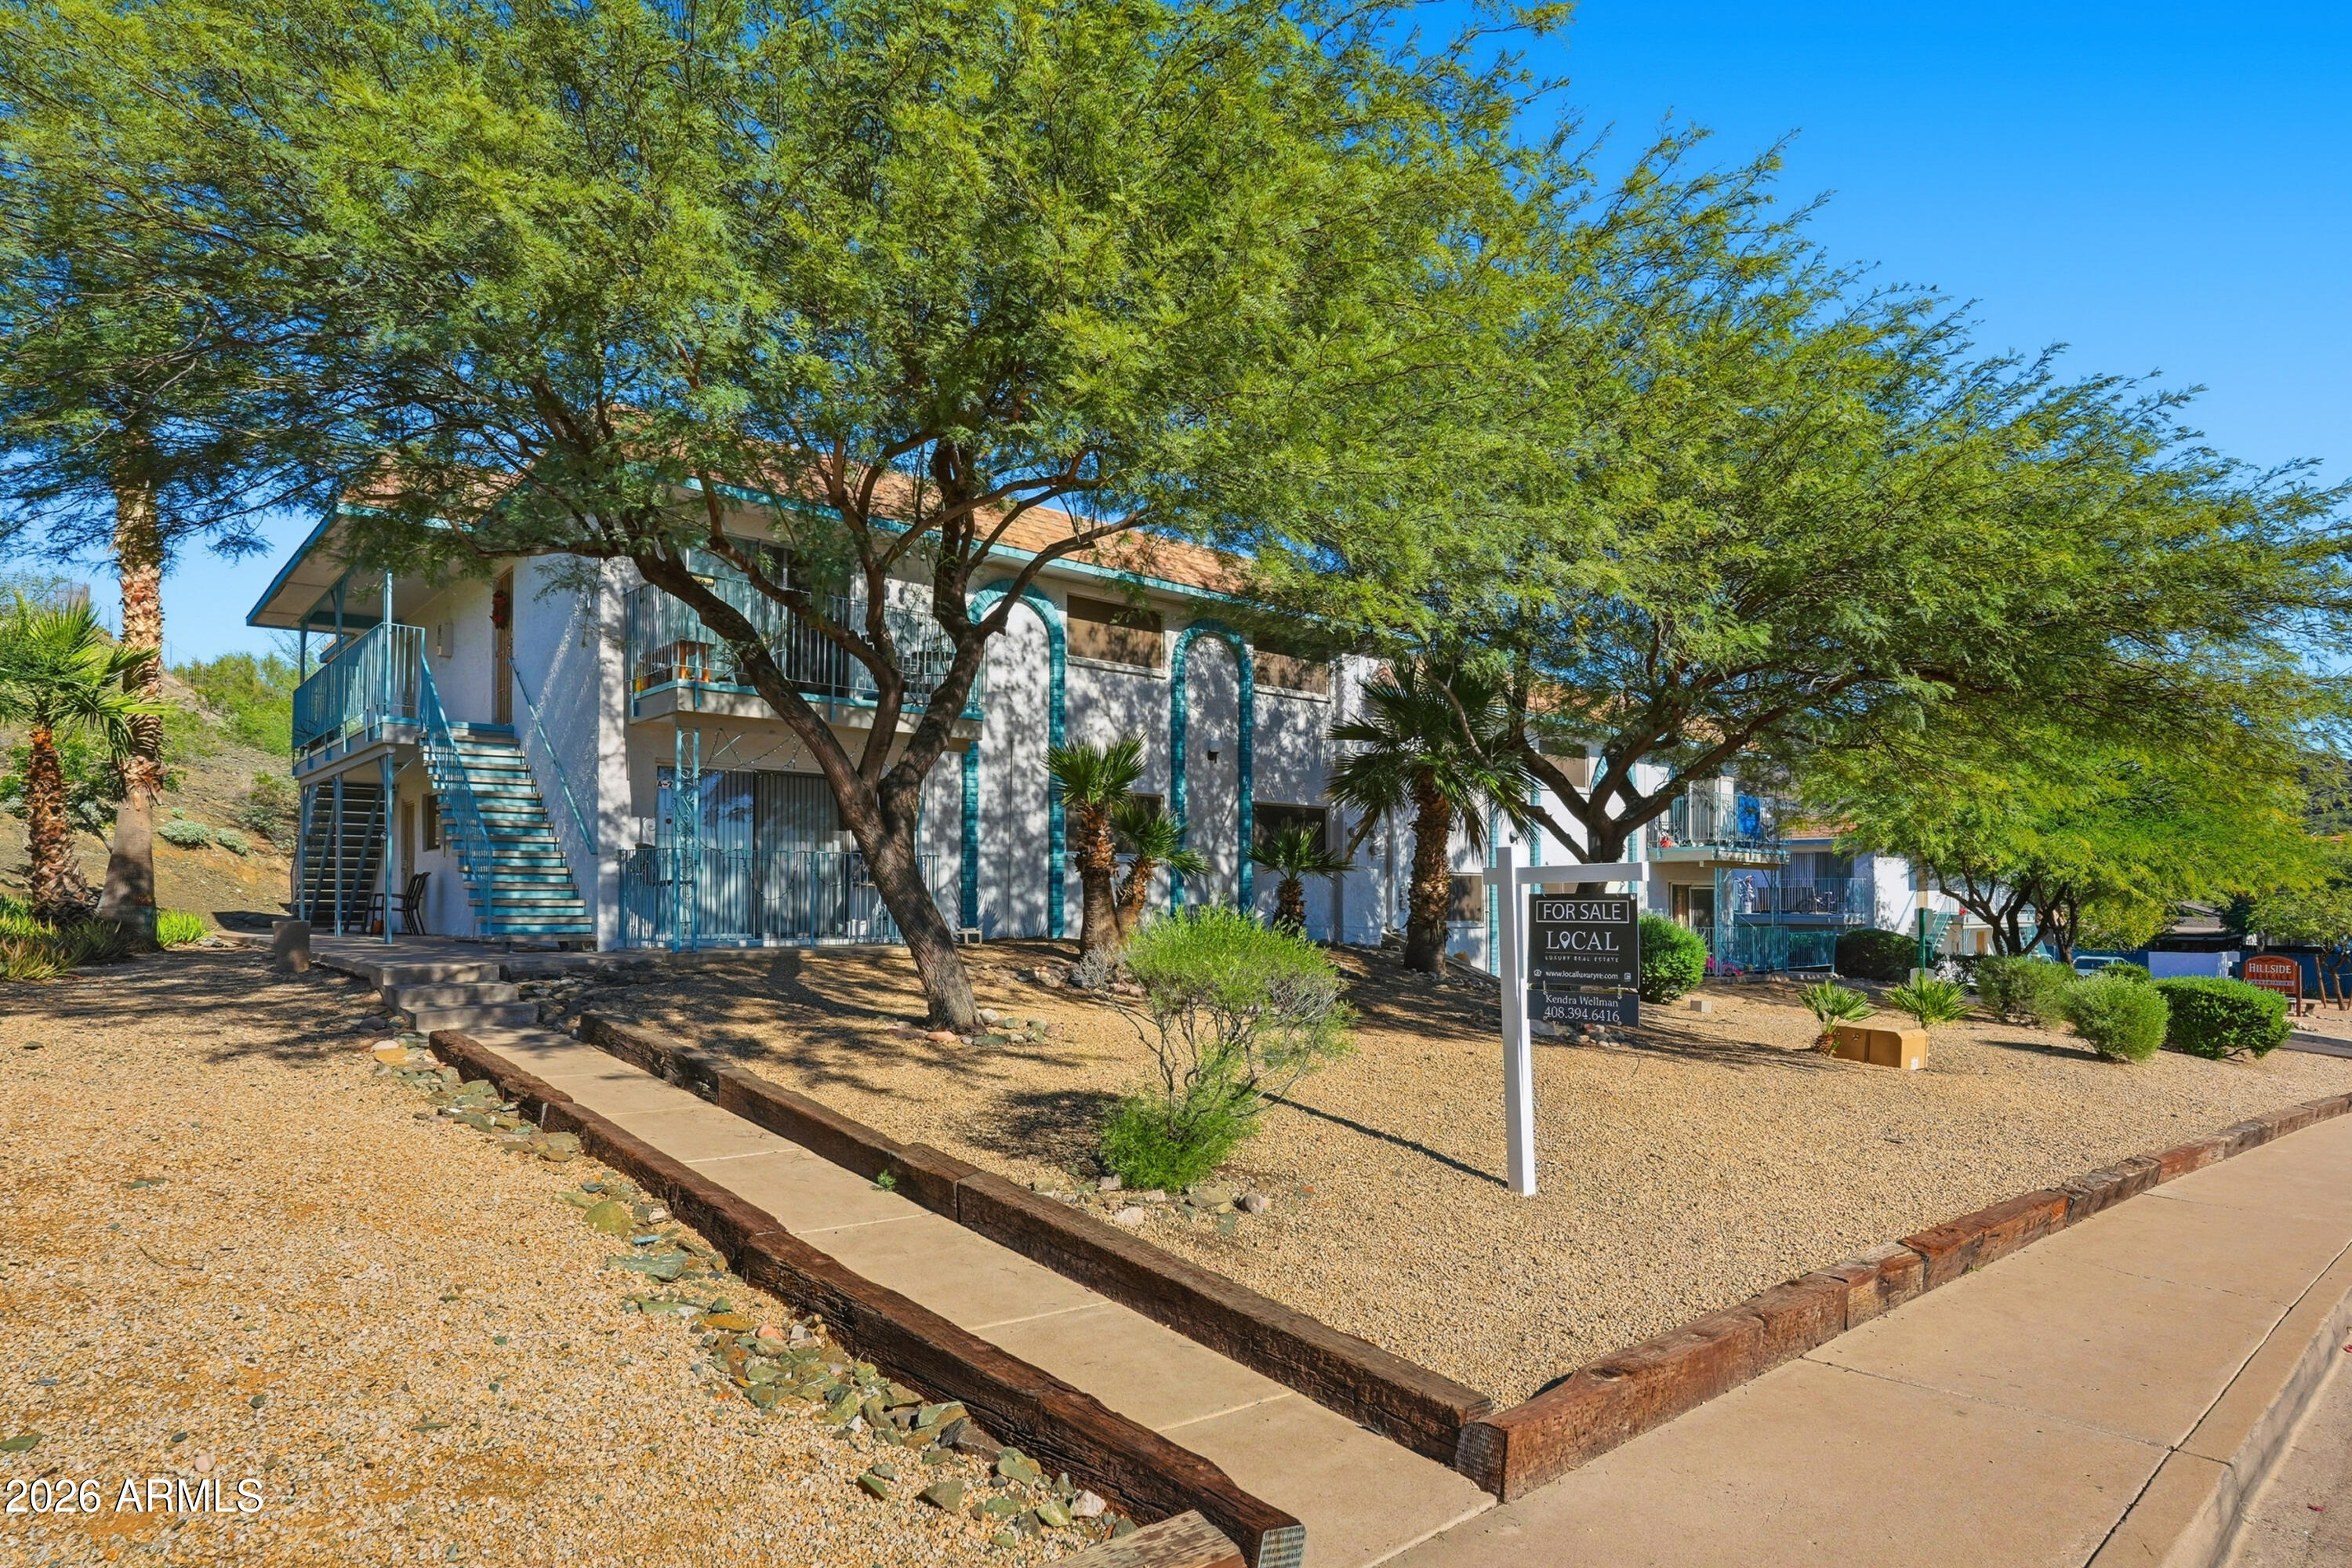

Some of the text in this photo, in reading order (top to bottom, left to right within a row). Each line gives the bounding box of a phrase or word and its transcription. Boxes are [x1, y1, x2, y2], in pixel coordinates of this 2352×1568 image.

[1543, 903, 1621, 920] FOR SALE
[1545, 931, 1619, 951] LOCAL
[2249, 963, 2292, 974] HILLSIDE
[1545, 994, 1619, 1007] Kendra Wellman
[1544, 1006, 1620, 1022] 408.394.6416
